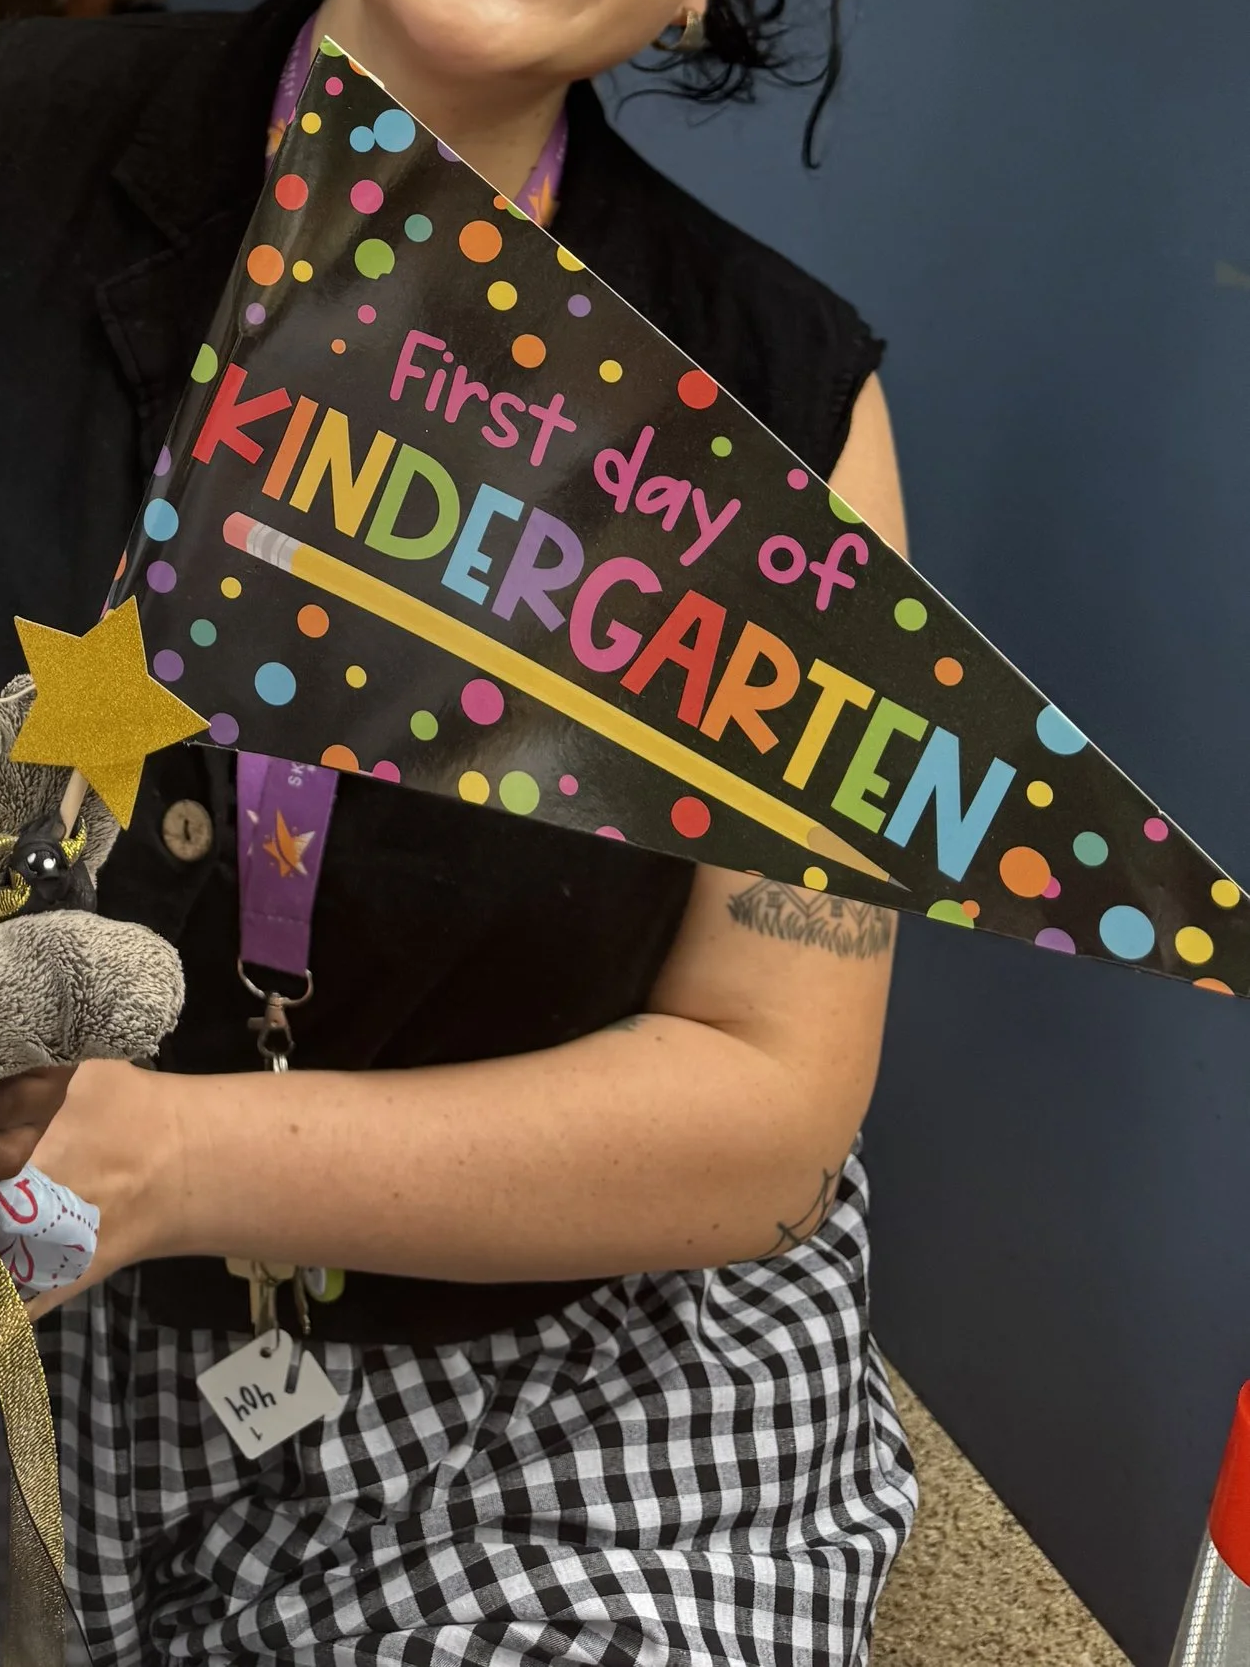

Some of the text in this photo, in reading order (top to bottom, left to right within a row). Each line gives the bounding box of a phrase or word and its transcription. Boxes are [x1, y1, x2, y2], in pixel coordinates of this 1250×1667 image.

[192, 362, 1017, 883] KINDERGARTEN
[389, 330, 869, 612] First day of
